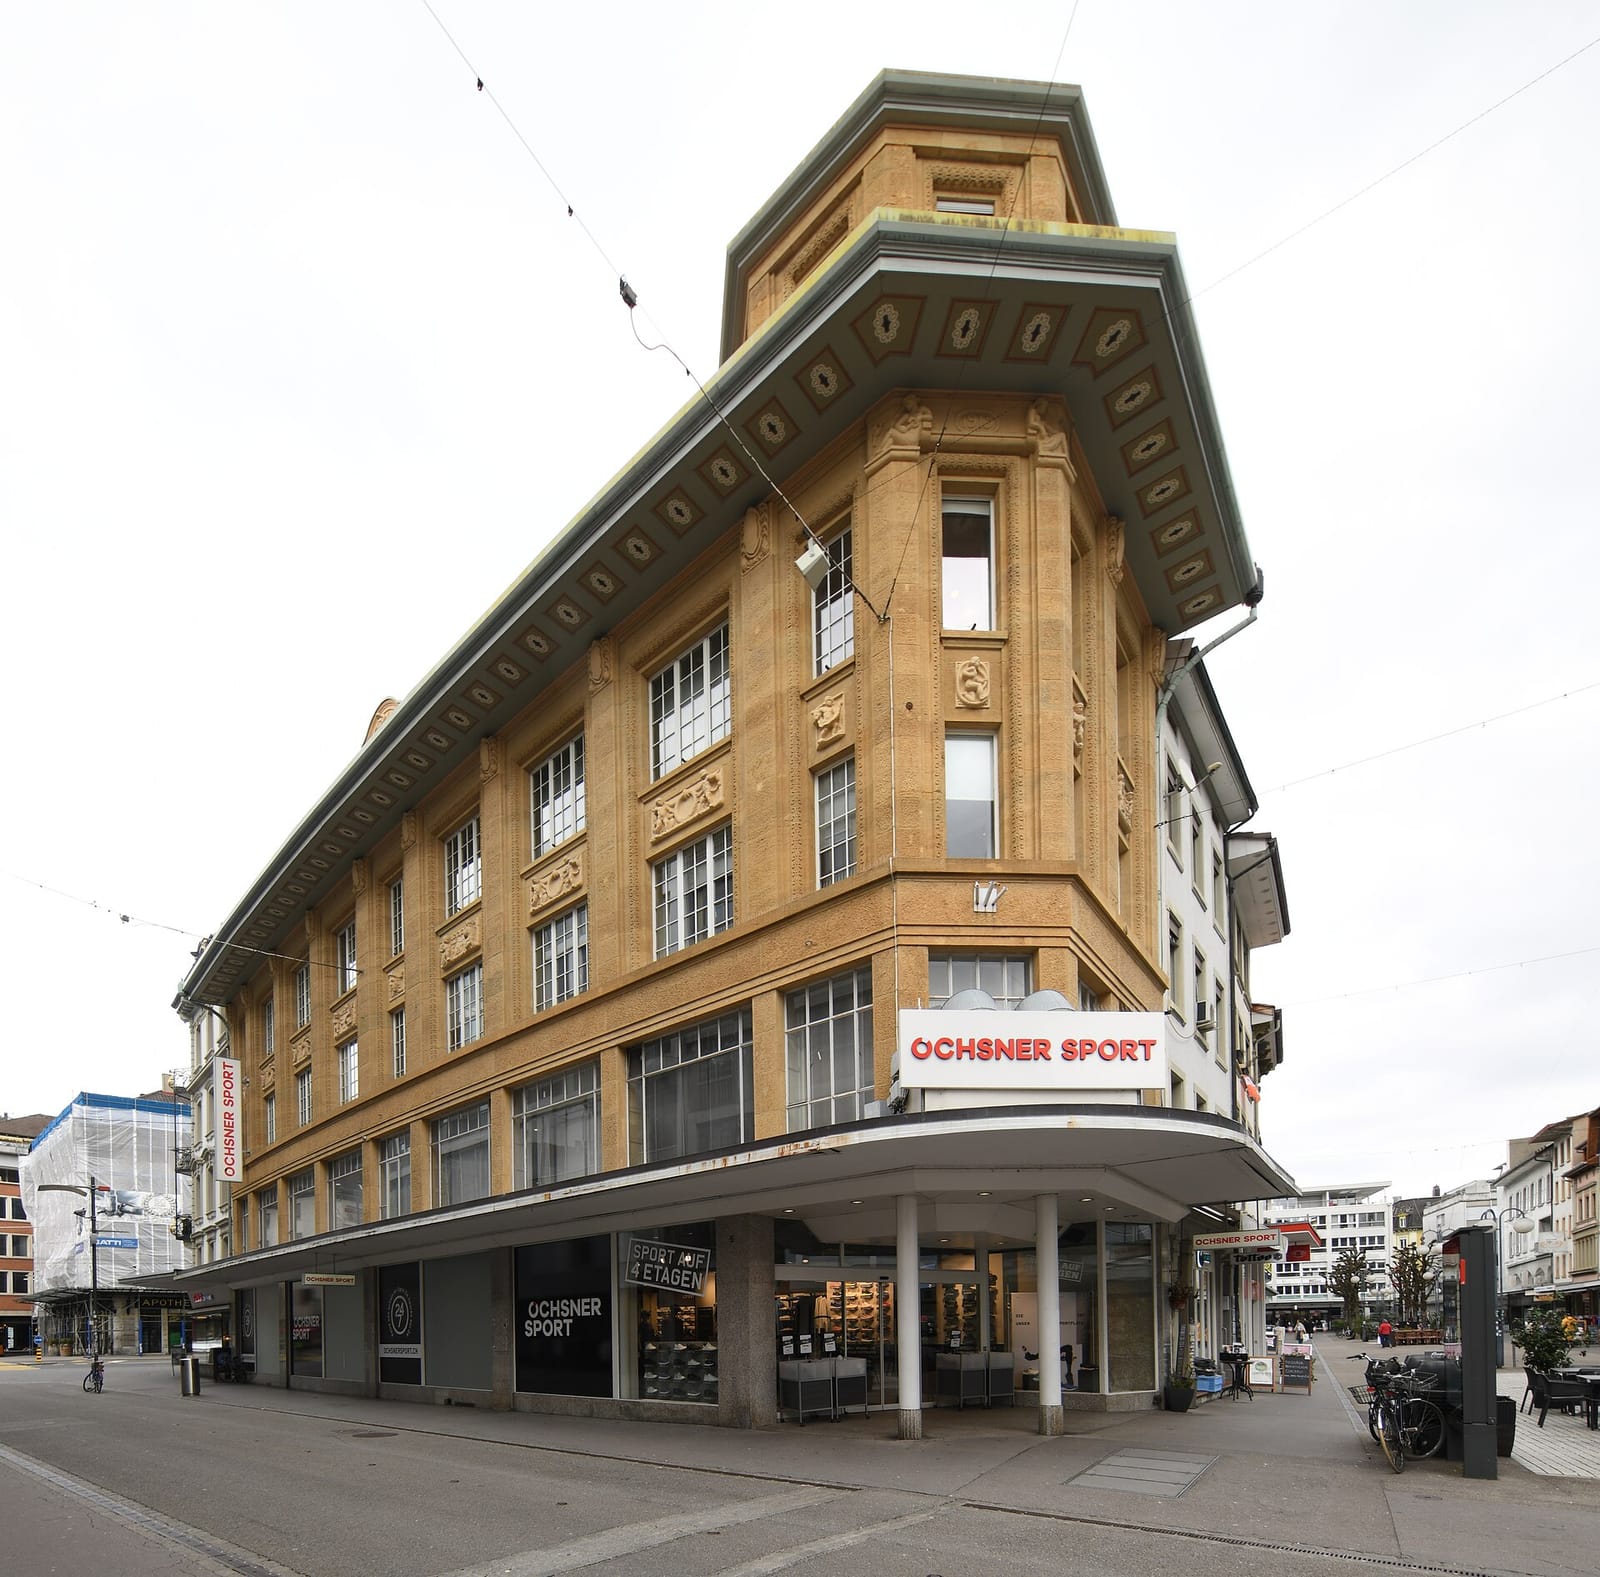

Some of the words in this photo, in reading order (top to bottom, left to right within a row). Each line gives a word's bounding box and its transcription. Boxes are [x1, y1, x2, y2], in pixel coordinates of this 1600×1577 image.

[910, 1037, 1052, 1060] OCHSNER
[1061, 1038, 1157, 1061] SPORT
[223, 1061, 234, 1107] SPORT
[223, 1111, 236, 1177] OCHSNER
[1195, 1236, 1241, 1246] OCHSNER
[1243, 1234, 1277, 1243] SPORT
[632, 1244, 675, 1264] SPORT
[677, 1251, 705, 1269] AUF
[630, 1261, 640, 1278] 4
[643, 1264, 703, 1290] ETAGEN
[1059, 1269, 1080, 1279] GEN
[527, 1297, 602, 1319] OCHSNER
[293, 1315, 320, 1328] OCHSNER
[524, 1319, 573, 1337] SPORT
[292, 1328, 310, 1340] SPORT
